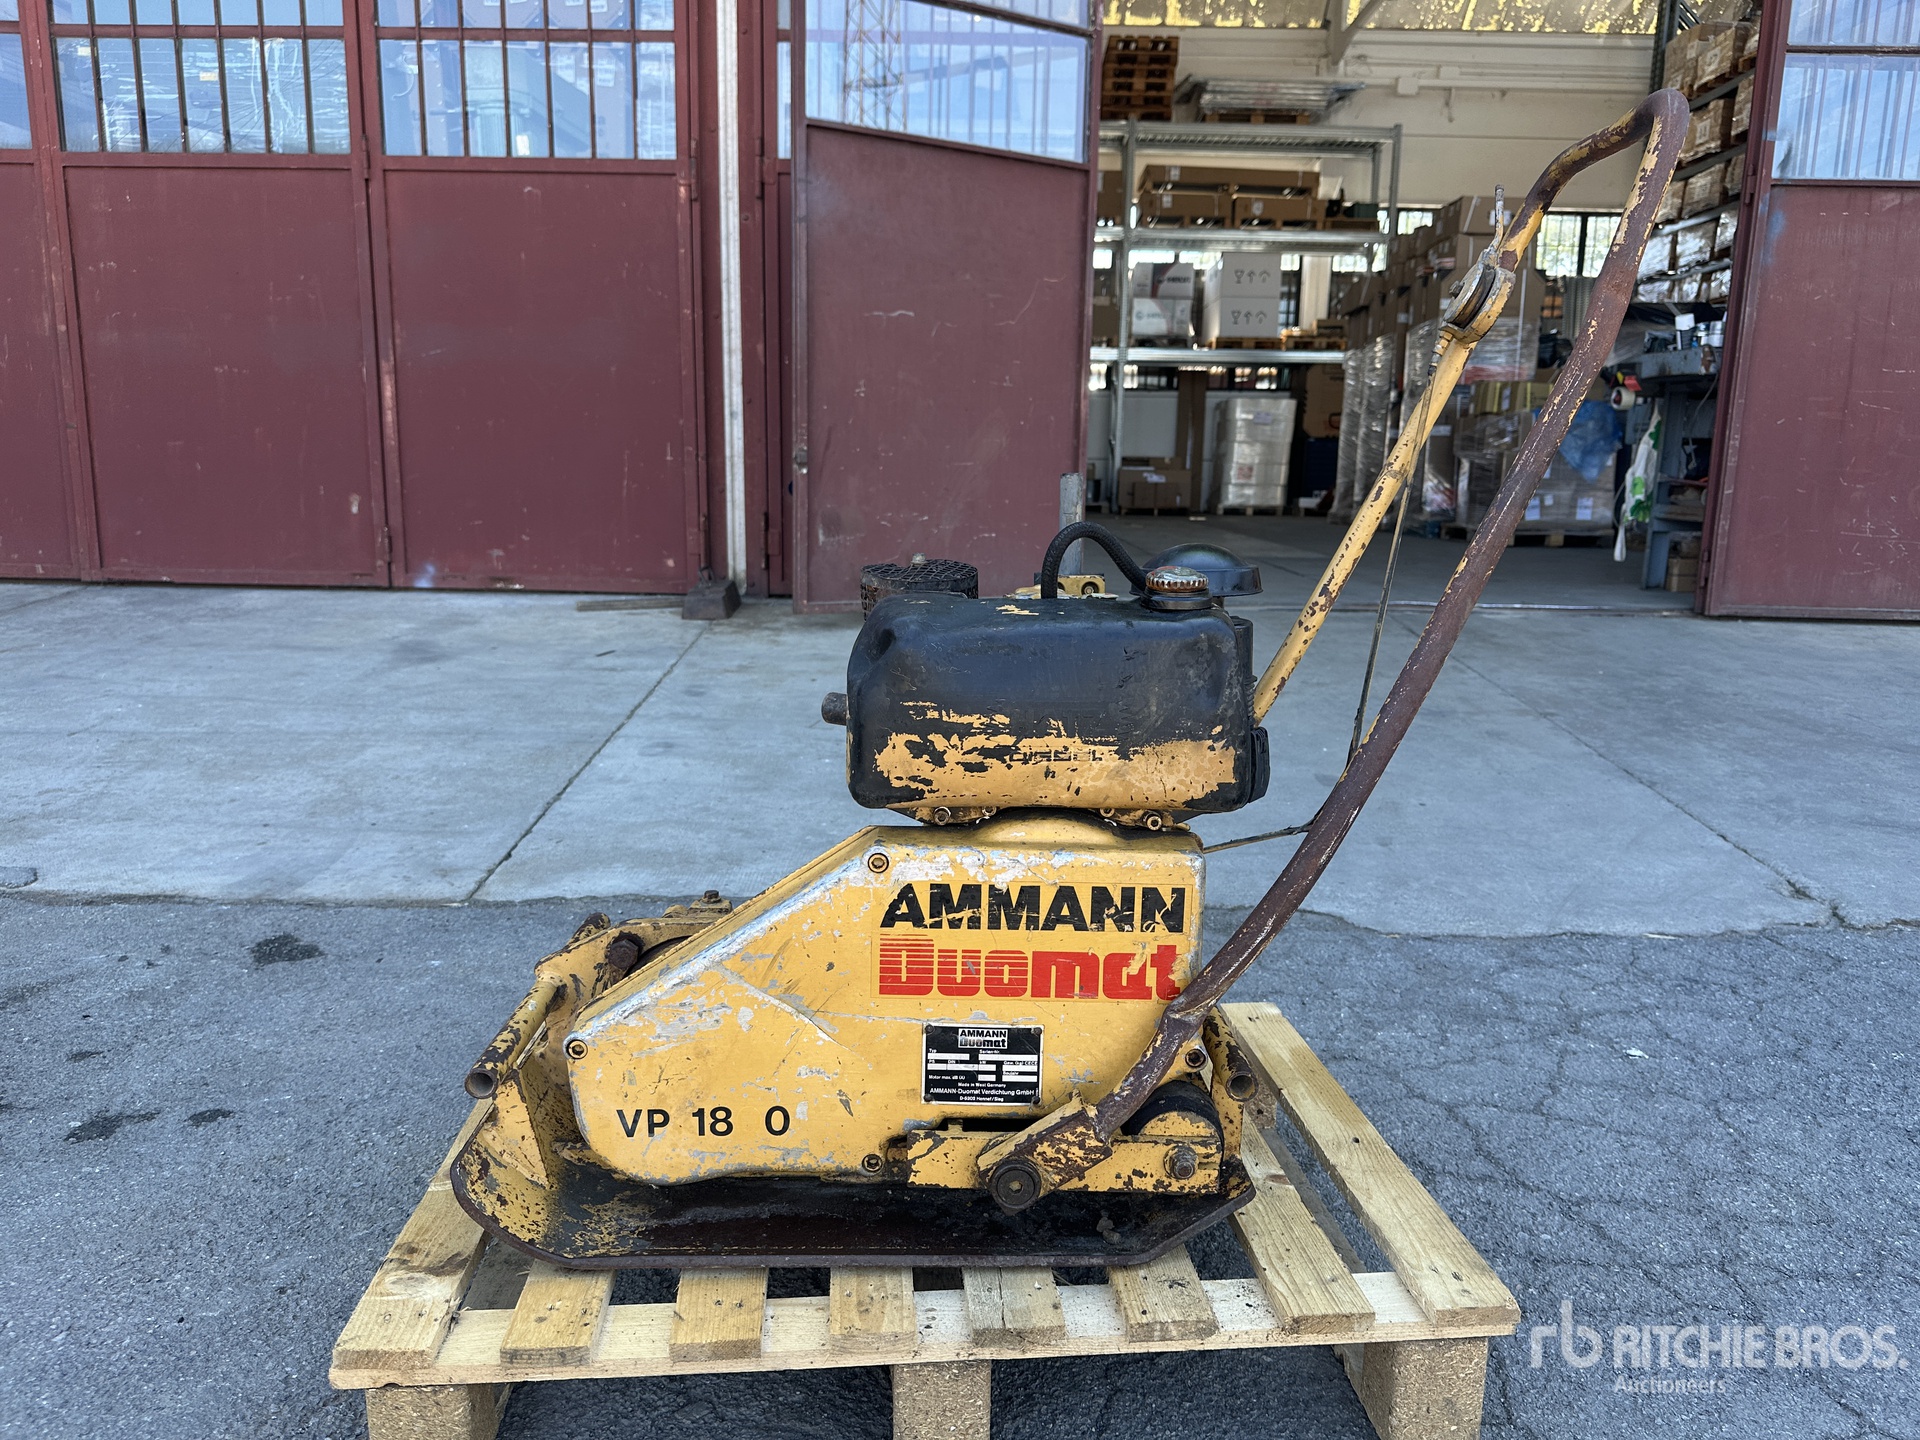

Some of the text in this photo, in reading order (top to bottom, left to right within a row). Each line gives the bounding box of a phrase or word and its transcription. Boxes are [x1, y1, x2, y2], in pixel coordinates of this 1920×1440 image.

[879, 882, 1186, 933] AMMANN
[879, 934, 1183, 1000] Duomat
[959, 1029, 1007, 1038] AMMANN
[616, 1108, 670, 1138] VP
